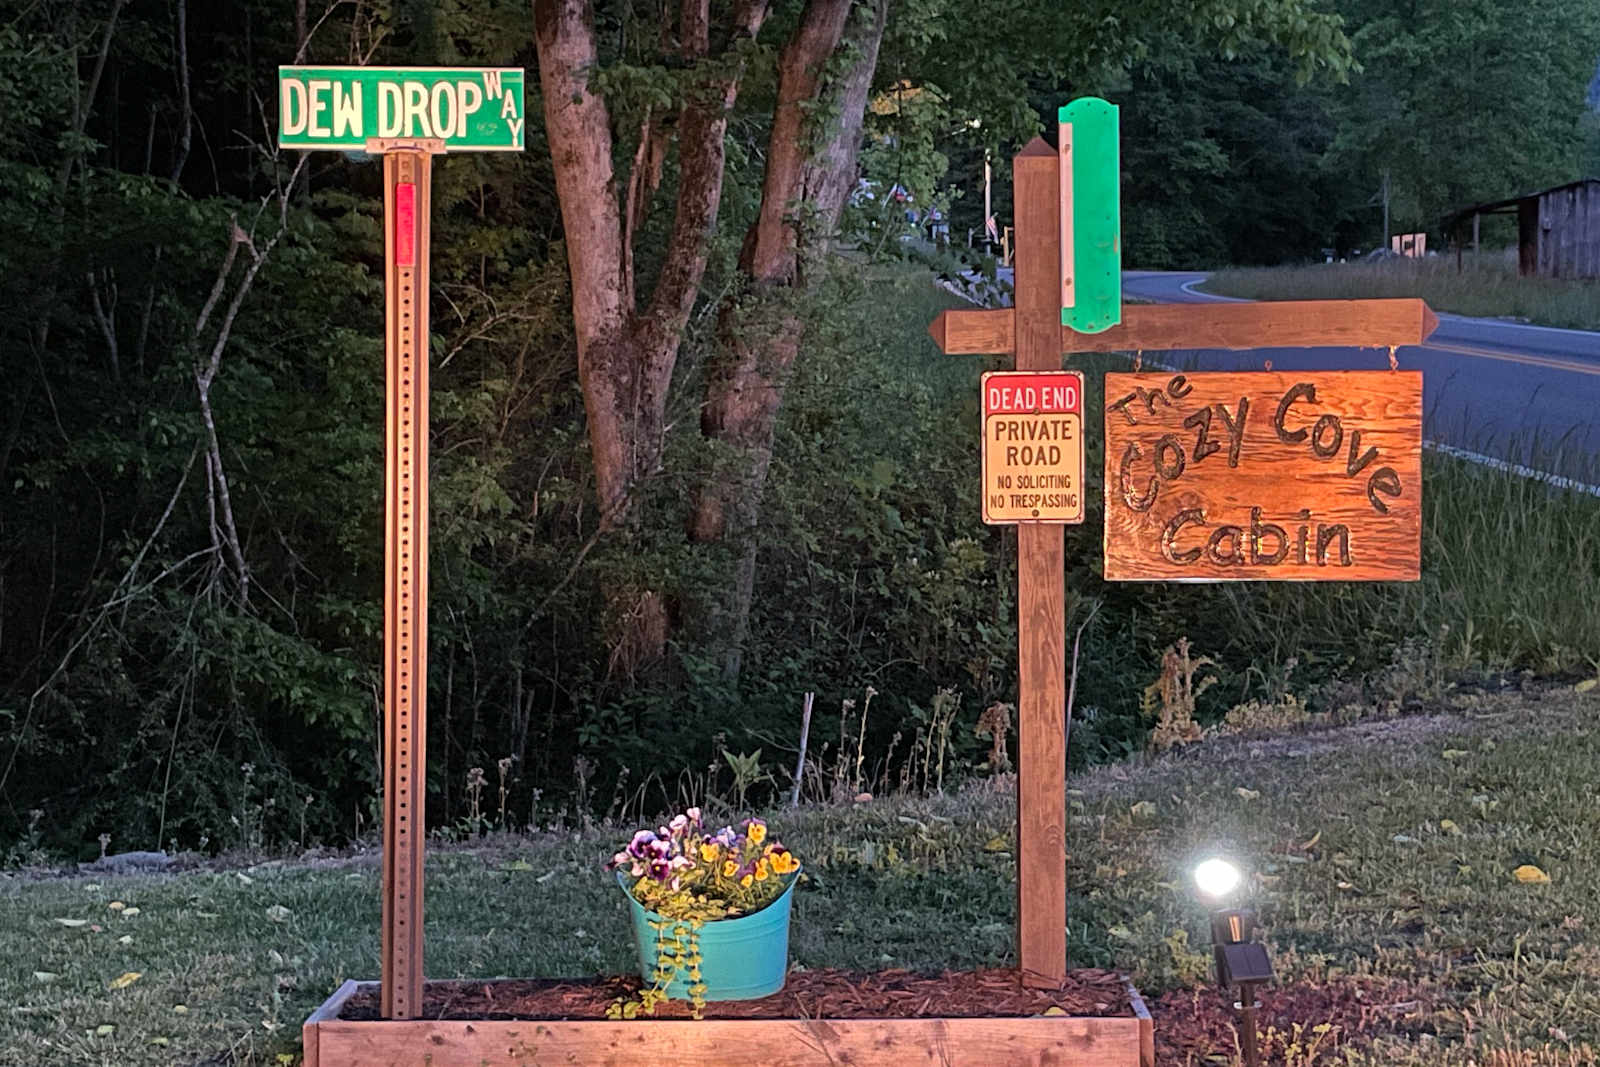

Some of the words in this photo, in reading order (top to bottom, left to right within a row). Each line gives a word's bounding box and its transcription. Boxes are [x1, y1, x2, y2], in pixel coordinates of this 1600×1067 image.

[282, 78, 363, 138] DEW
[378, 80, 483, 139] DROP
[483, 71, 523, 147] WAY
[989, 387, 1036, 410] DEAD
[1041, 386, 1077, 409] END
[1107, 374, 1194, 426] The
[995, 420, 1072, 441] PRIVATE
[1006, 445, 1061, 466] ROAD
[1273, 382, 1403, 515] Cove
[997, 475, 1012, 489] NO
[1017, 474, 1071, 489] SOLICITING
[990, 494, 1005, 508] NO
[1010, 494, 1077, 508] TRESPASSING
[1160, 505, 1353, 567] Cabin
